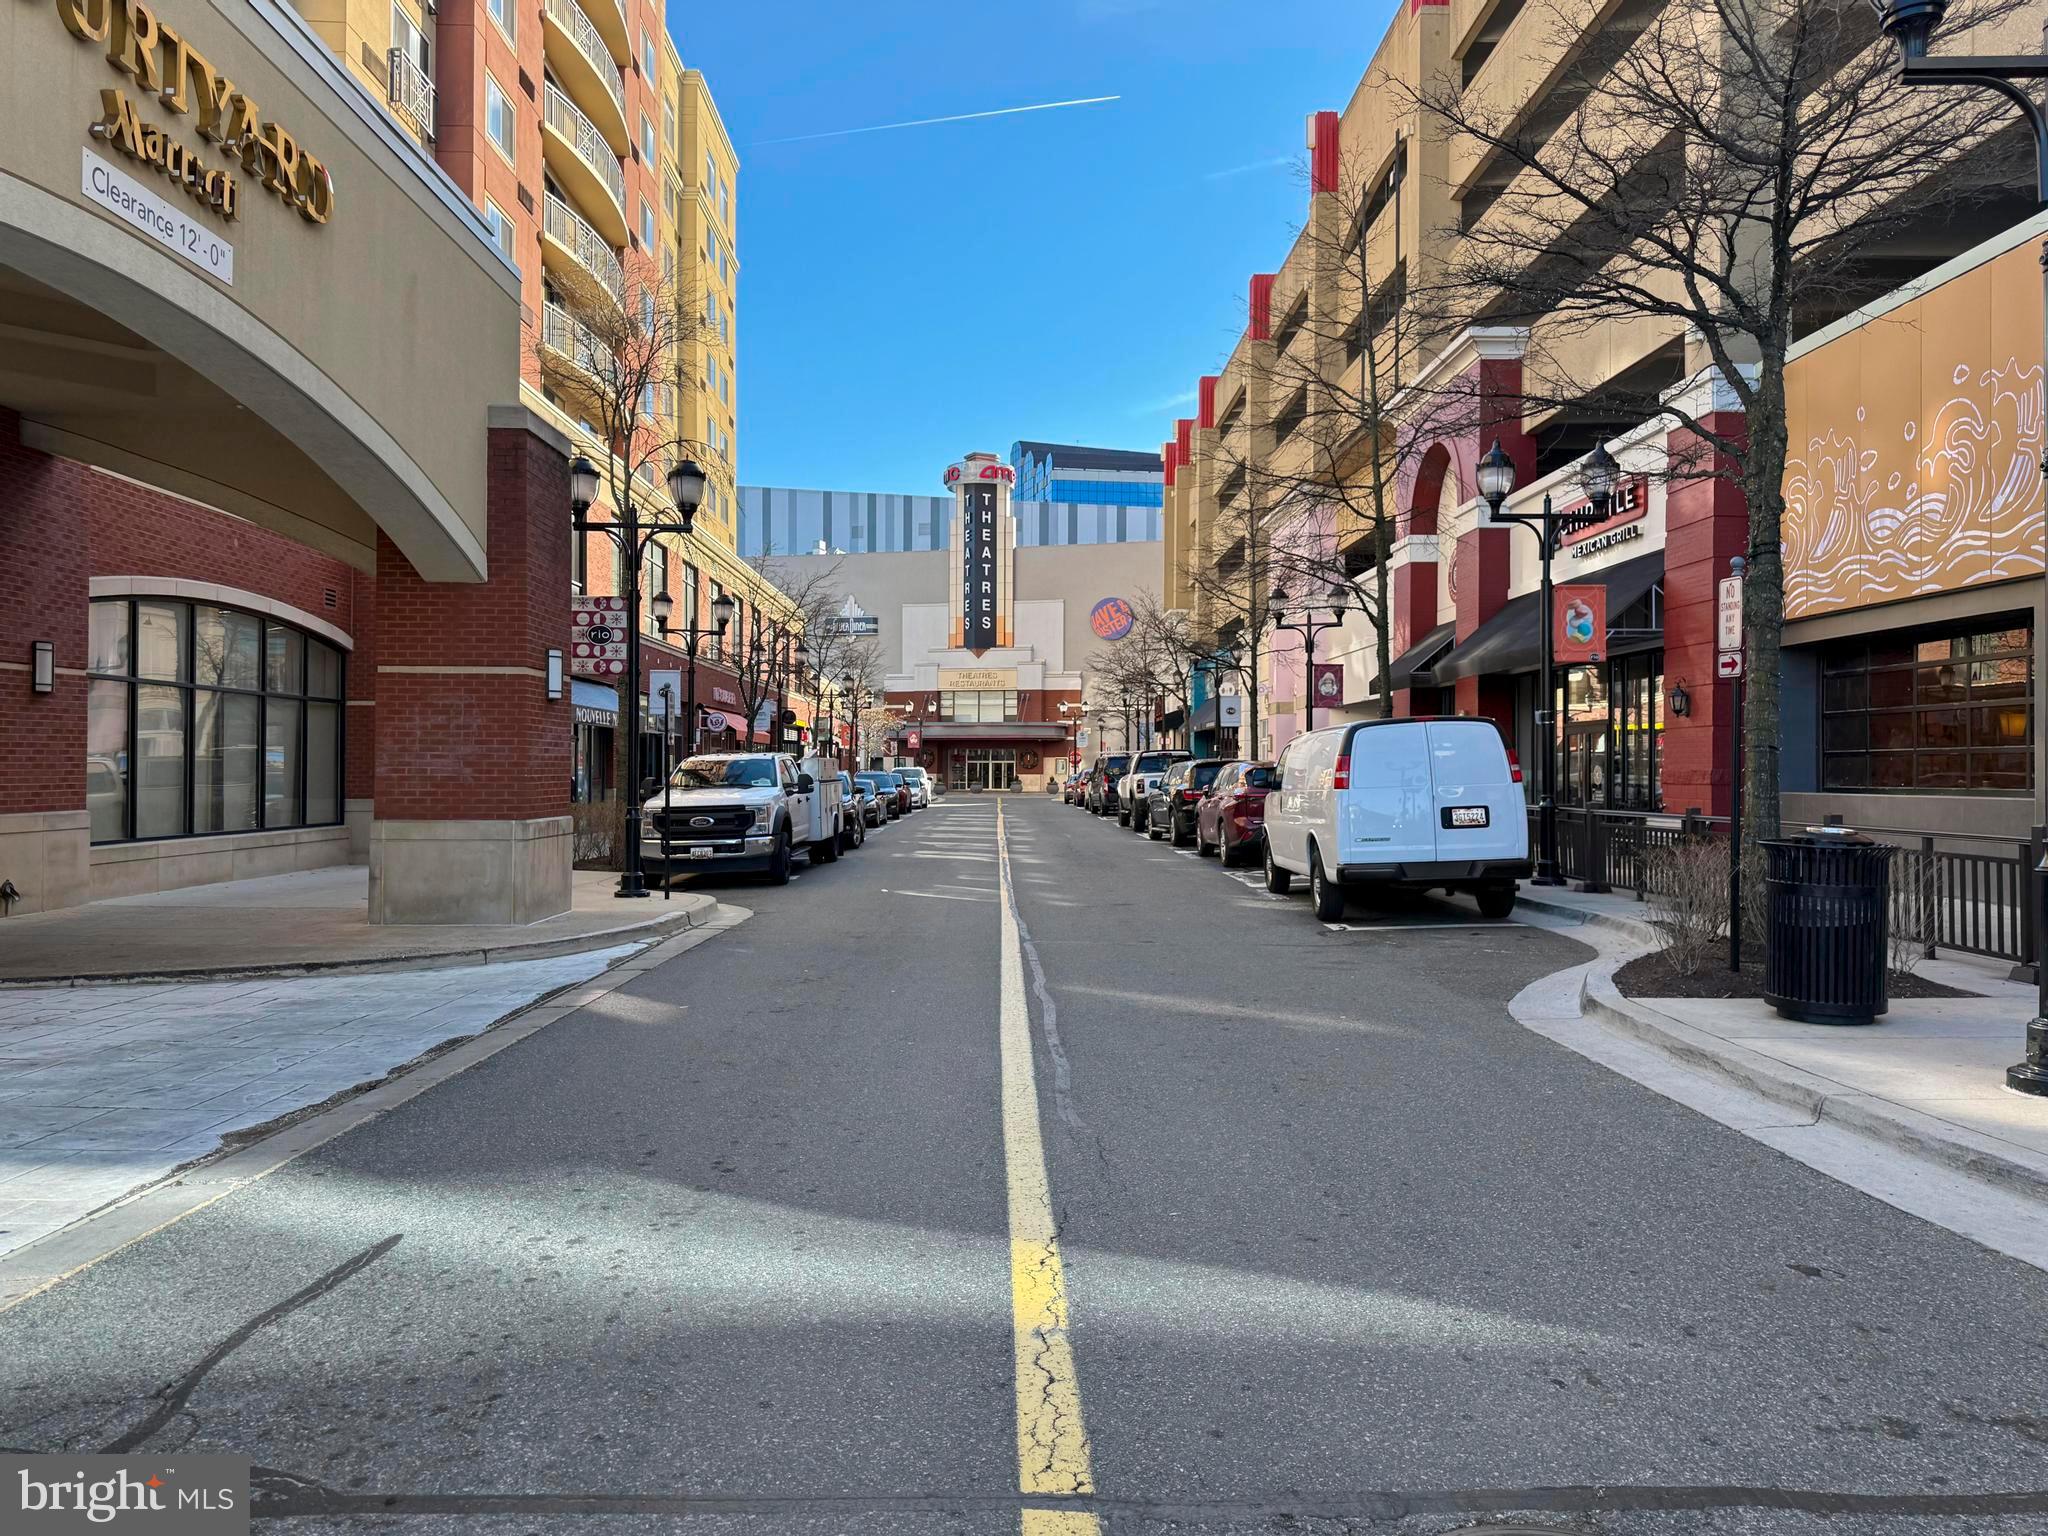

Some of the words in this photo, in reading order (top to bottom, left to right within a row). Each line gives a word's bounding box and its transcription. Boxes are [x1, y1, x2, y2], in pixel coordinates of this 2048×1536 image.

[92, 166, 174, 238] Clearance
[180, 224, 200, 253] 12'
[1560, 483, 1635, 535] CHIPTLE
[1571, 534, 1608, 558] MEXICAN
[1610, 524, 1639, 545] GRILL
[982, 493, 992, 629] THEATRES
[1726, 585, 1736, 599] NO
[1721, 600, 1741, 612] STANDING
[1726, 614, 1736, 623] ANY
[590, 629, 610, 639] rio
[1725, 625, 1736, 636] TIME
[958, 671, 998, 680] THEATRES
[949, 680, 1006, 688] RESTAURANTS
[576, 706, 610, 726] NOUVELLE
